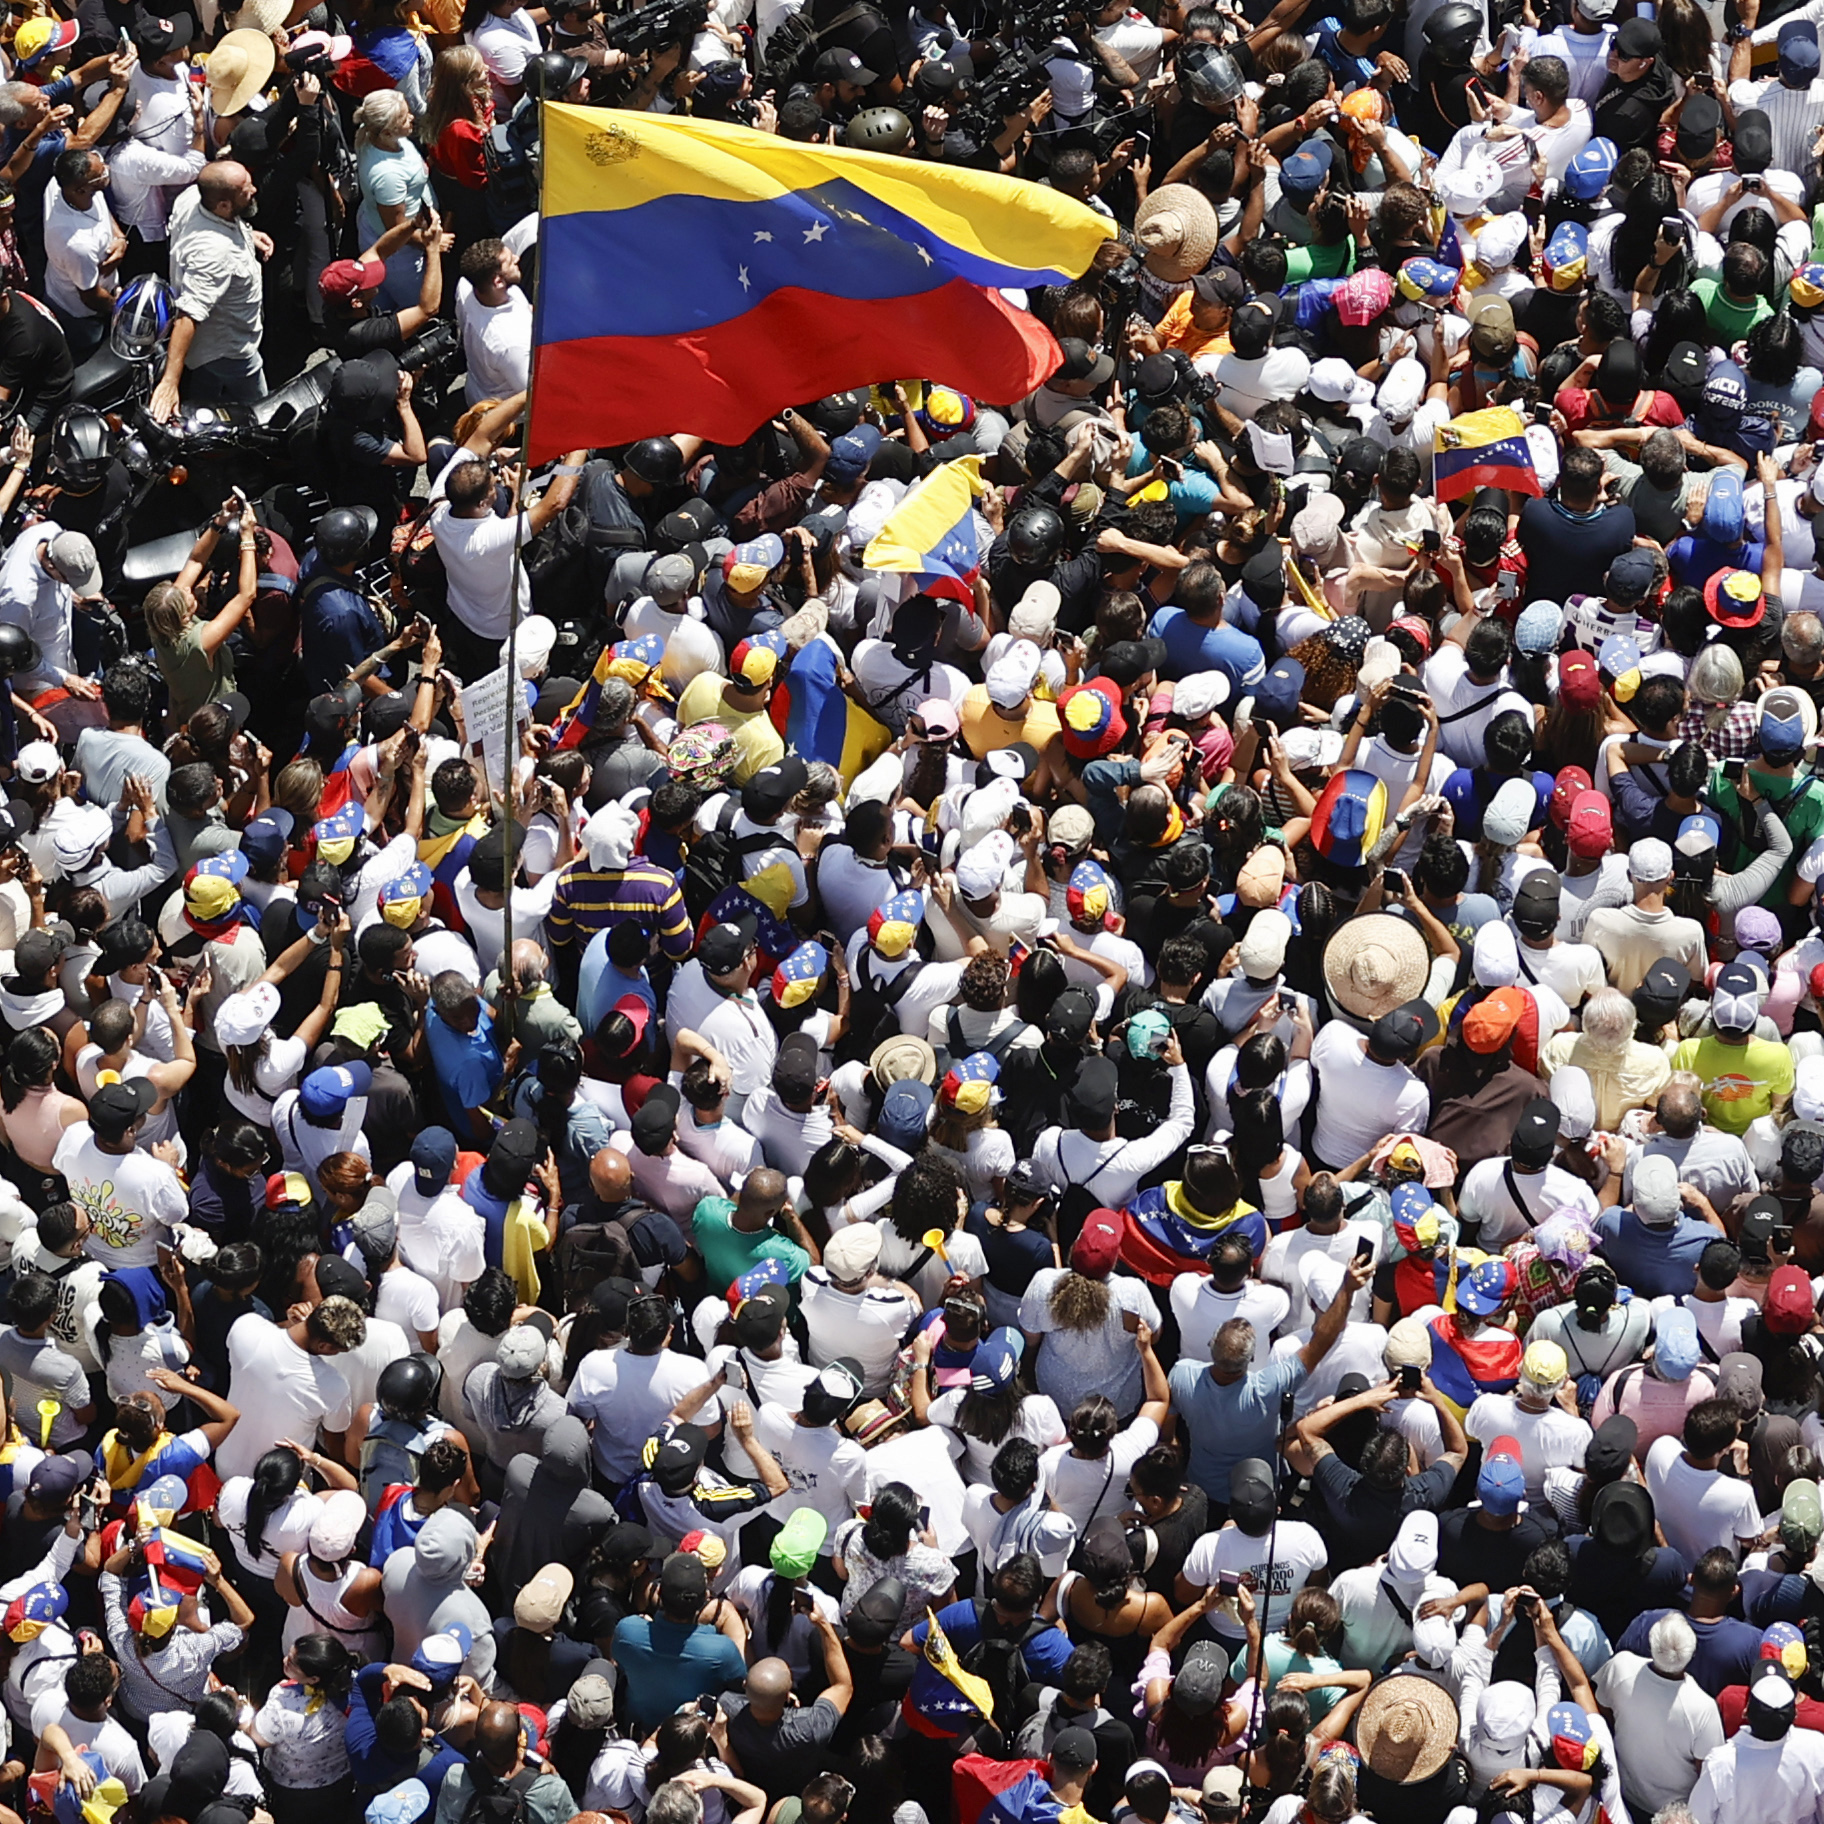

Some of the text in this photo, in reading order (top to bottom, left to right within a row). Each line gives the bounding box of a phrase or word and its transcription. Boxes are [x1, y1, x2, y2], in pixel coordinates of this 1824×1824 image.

[1747, 396, 1797, 417] OOKLYN
[479, 681, 491, 691] No
[472, 719, 487, 730] por
[490, 713, 519, 732] Verd
[1249, 1560, 1290, 1573] CUIDNOS
